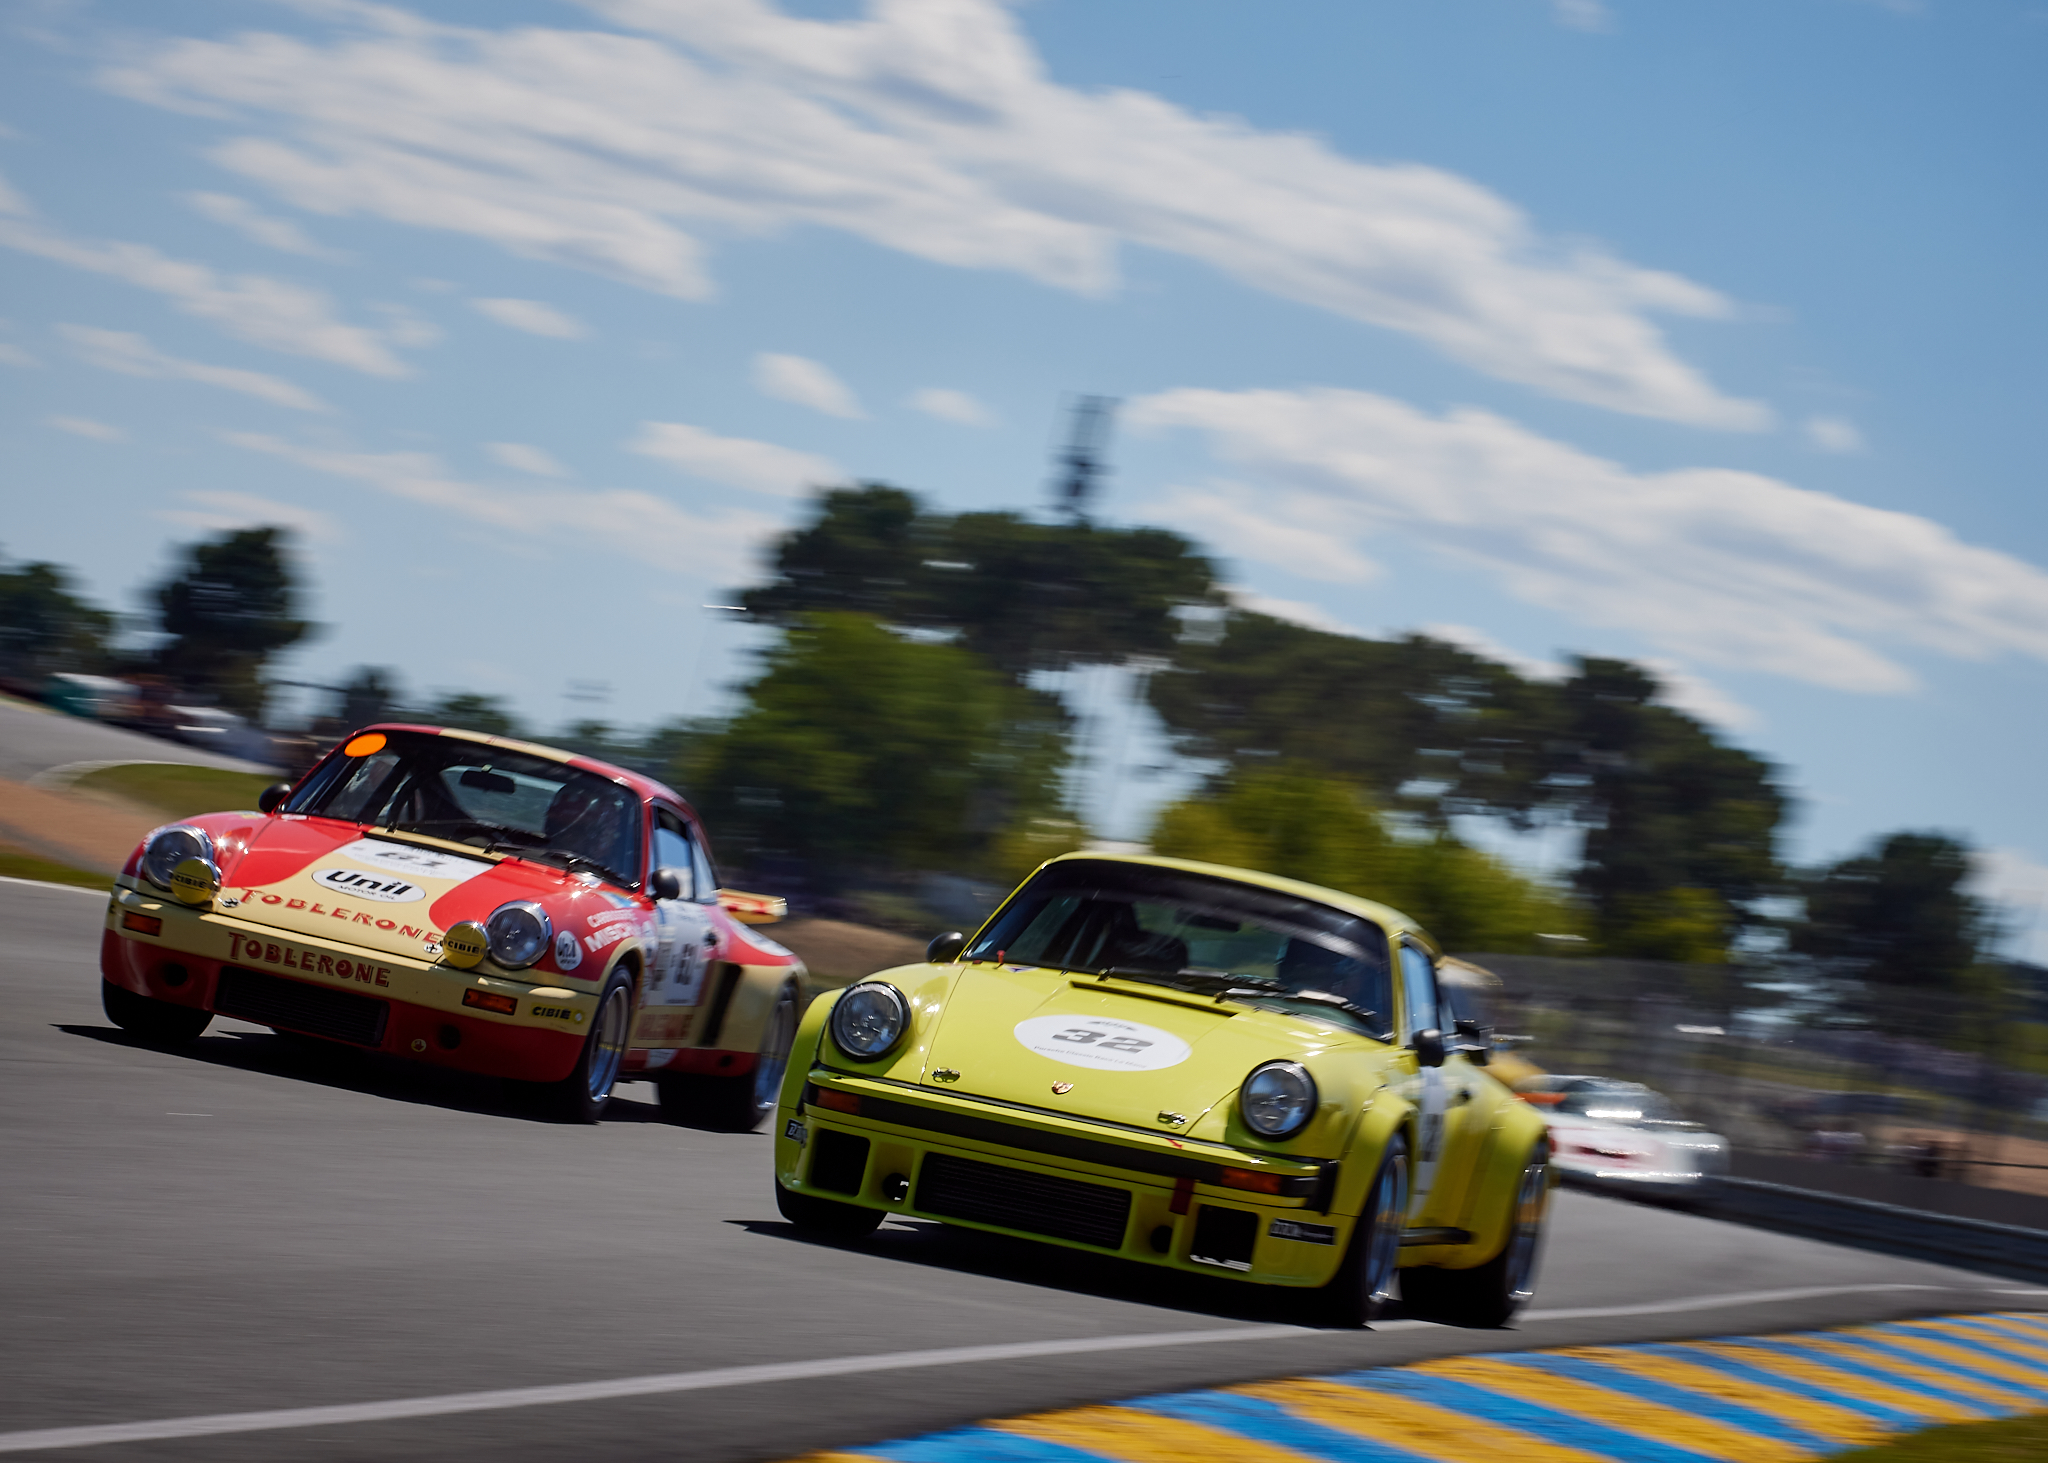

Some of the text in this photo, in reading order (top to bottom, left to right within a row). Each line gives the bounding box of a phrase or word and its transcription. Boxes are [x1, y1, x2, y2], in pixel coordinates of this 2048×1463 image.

[326, 870, 414, 896] Unil
[239, 887, 446, 946] TOBLERONE
[228, 931, 391, 988] TOBLERONE
[447, 939, 482, 955] CIBIE
[532, 1005, 572, 1020] CIBIE
[1051, 1028, 1154, 1055] 32
